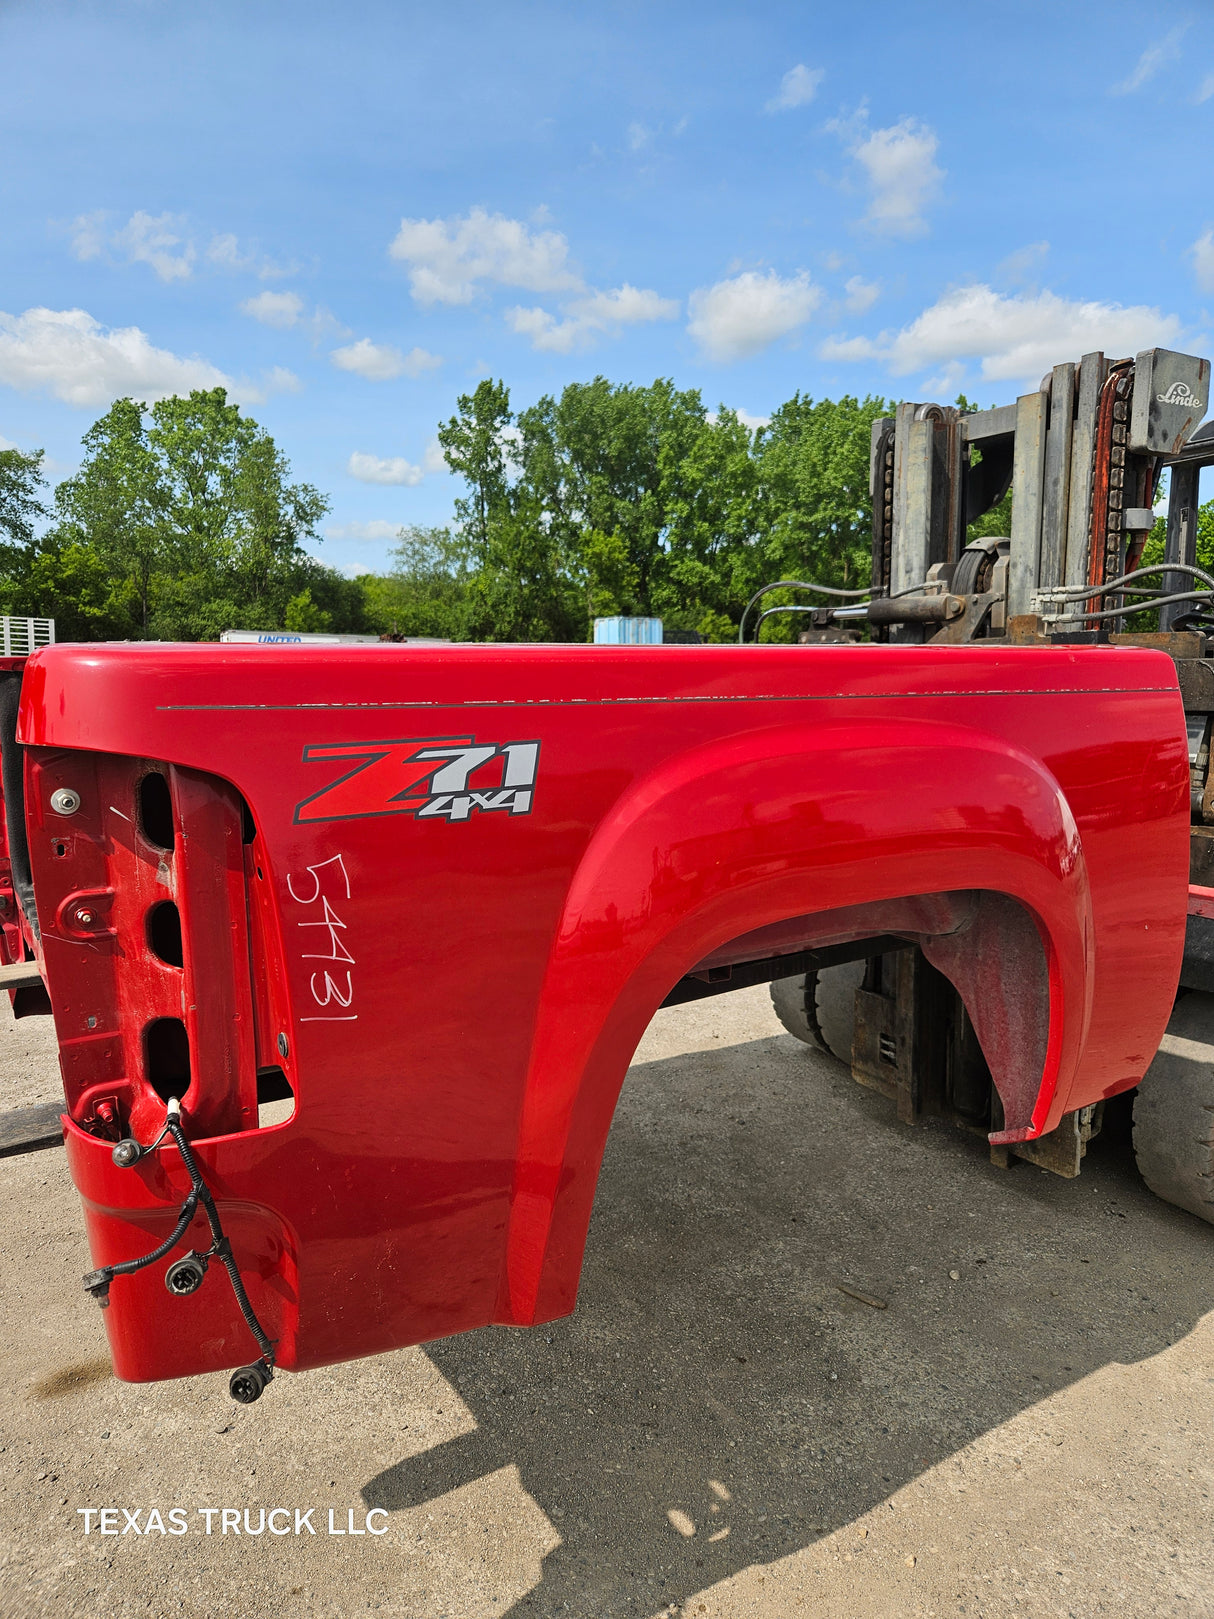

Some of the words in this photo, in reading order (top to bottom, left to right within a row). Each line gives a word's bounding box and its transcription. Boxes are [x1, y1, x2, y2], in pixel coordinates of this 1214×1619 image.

[1156, 381, 1203, 408] Linde
[258, 635, 302, 643] UNITED
[294, 735, 541, 824] Z71
[287, 853, 358, 1022] 54431
